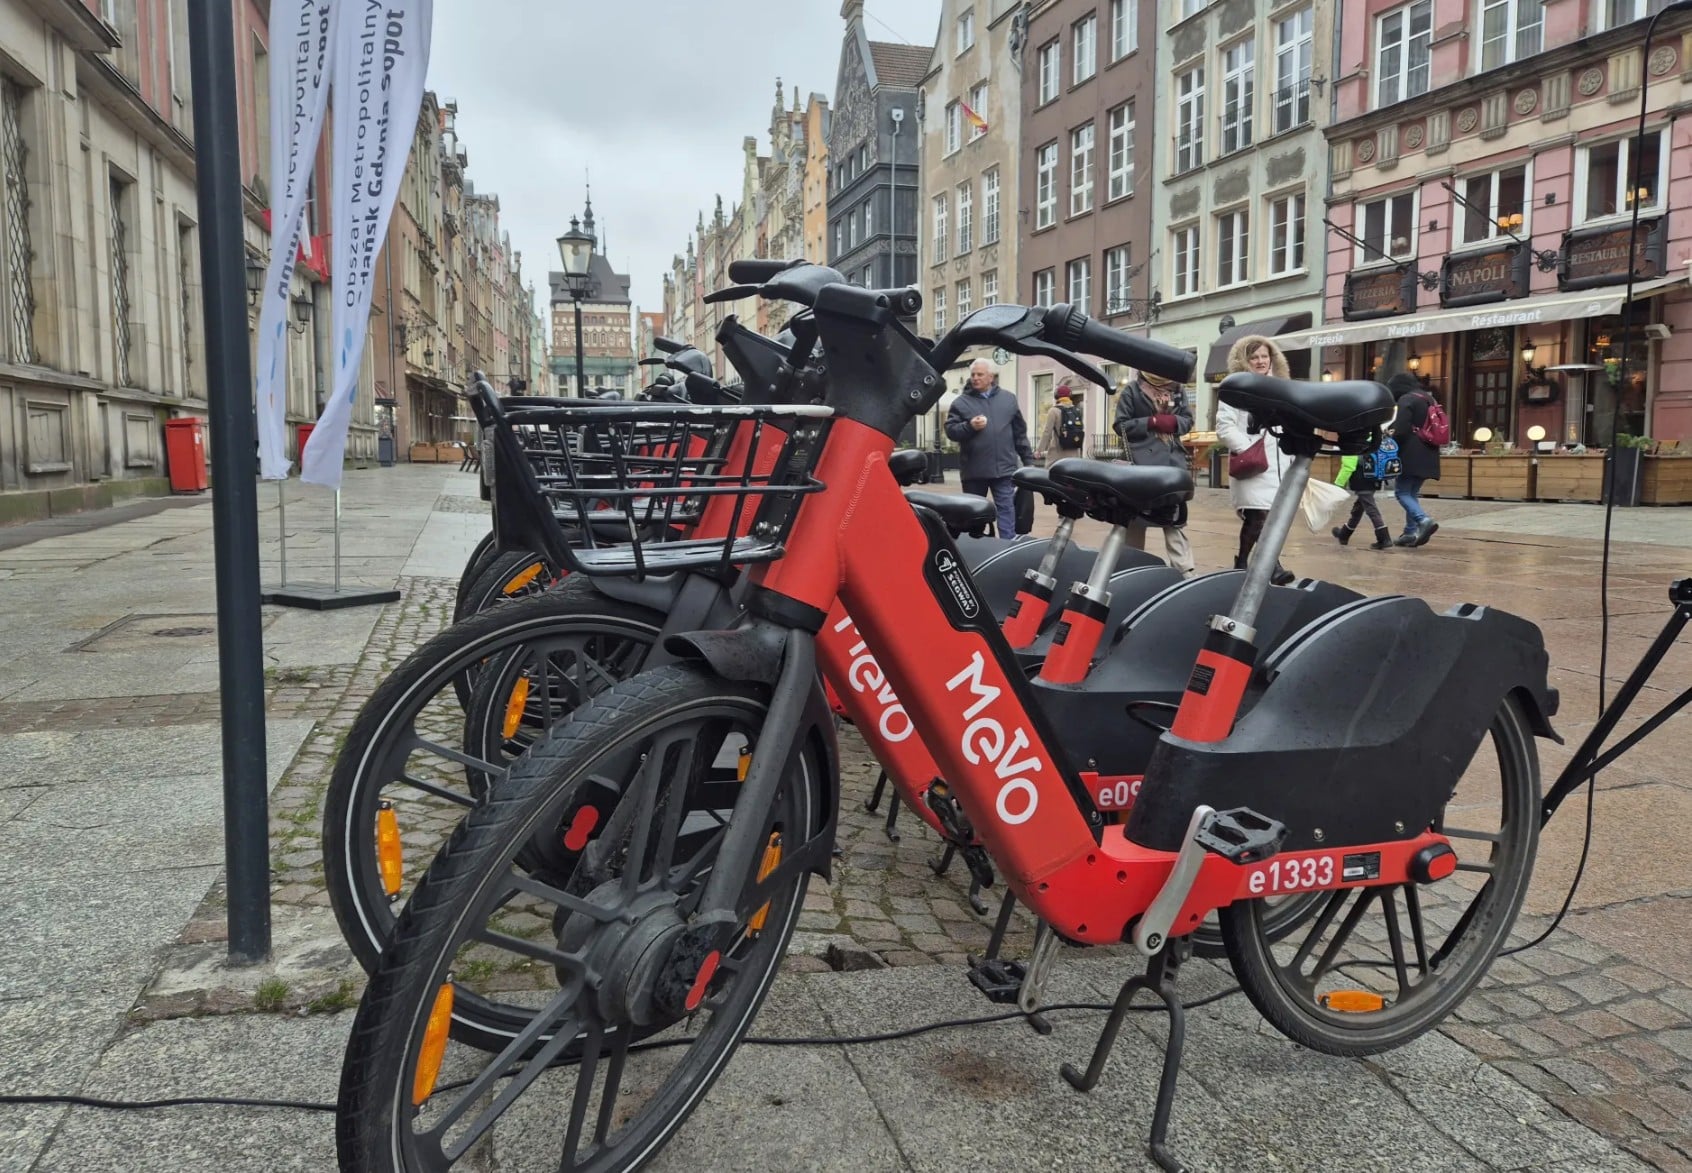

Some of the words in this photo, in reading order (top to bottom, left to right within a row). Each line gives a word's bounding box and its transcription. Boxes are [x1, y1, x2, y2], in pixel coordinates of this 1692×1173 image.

[351, 0, 382, 203] Metropolitalny
[346, 214, 360, 308] Obszar
[1354, 286, 1397, 301] PIZZERIA
[1452, 264, 1506, 287] NAPOLI
[1309, 332, 1344, 345] Pizzeria
[1387, 321, 1426, 337] Napoli
[1471, 308, 1542, 328] Restaurant
[947, 573, 972, 611] SEGWAY
[952, 569, 971, 600] POWERED
[1249, 856, 1334, 893] e1333
